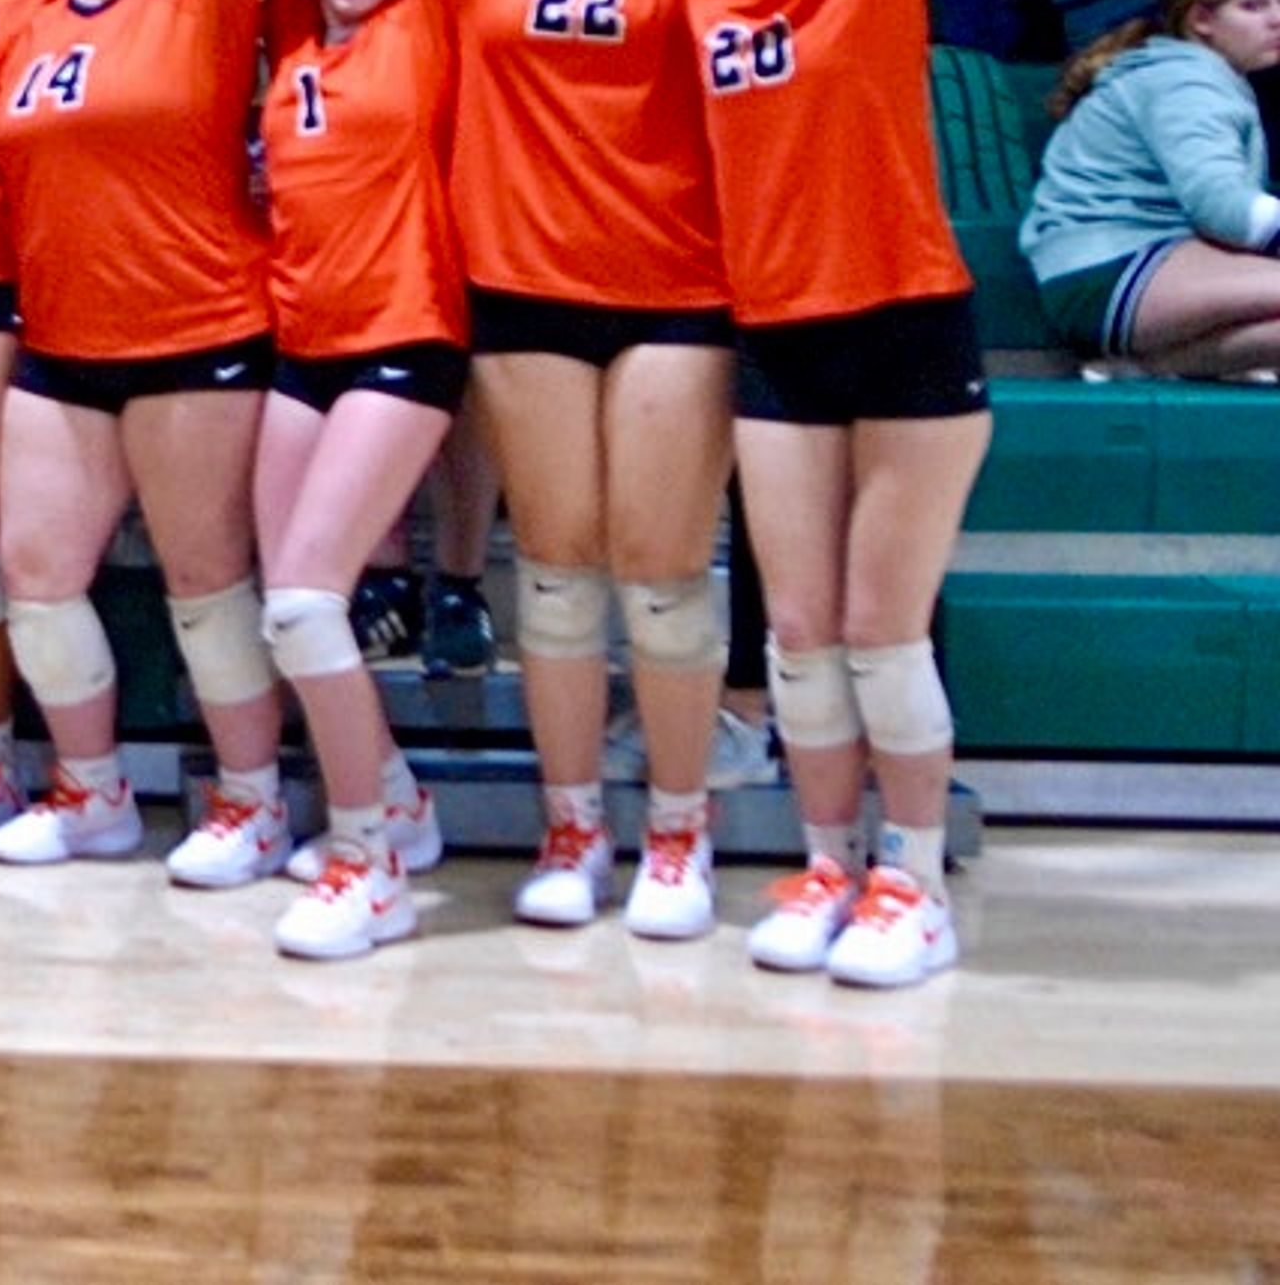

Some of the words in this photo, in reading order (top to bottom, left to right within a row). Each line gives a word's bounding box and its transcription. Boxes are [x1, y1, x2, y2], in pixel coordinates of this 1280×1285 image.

[9, 44, 95, 116] 14
[704, 12, 795, 95] 20
[294, 63, 327, 136] 1
